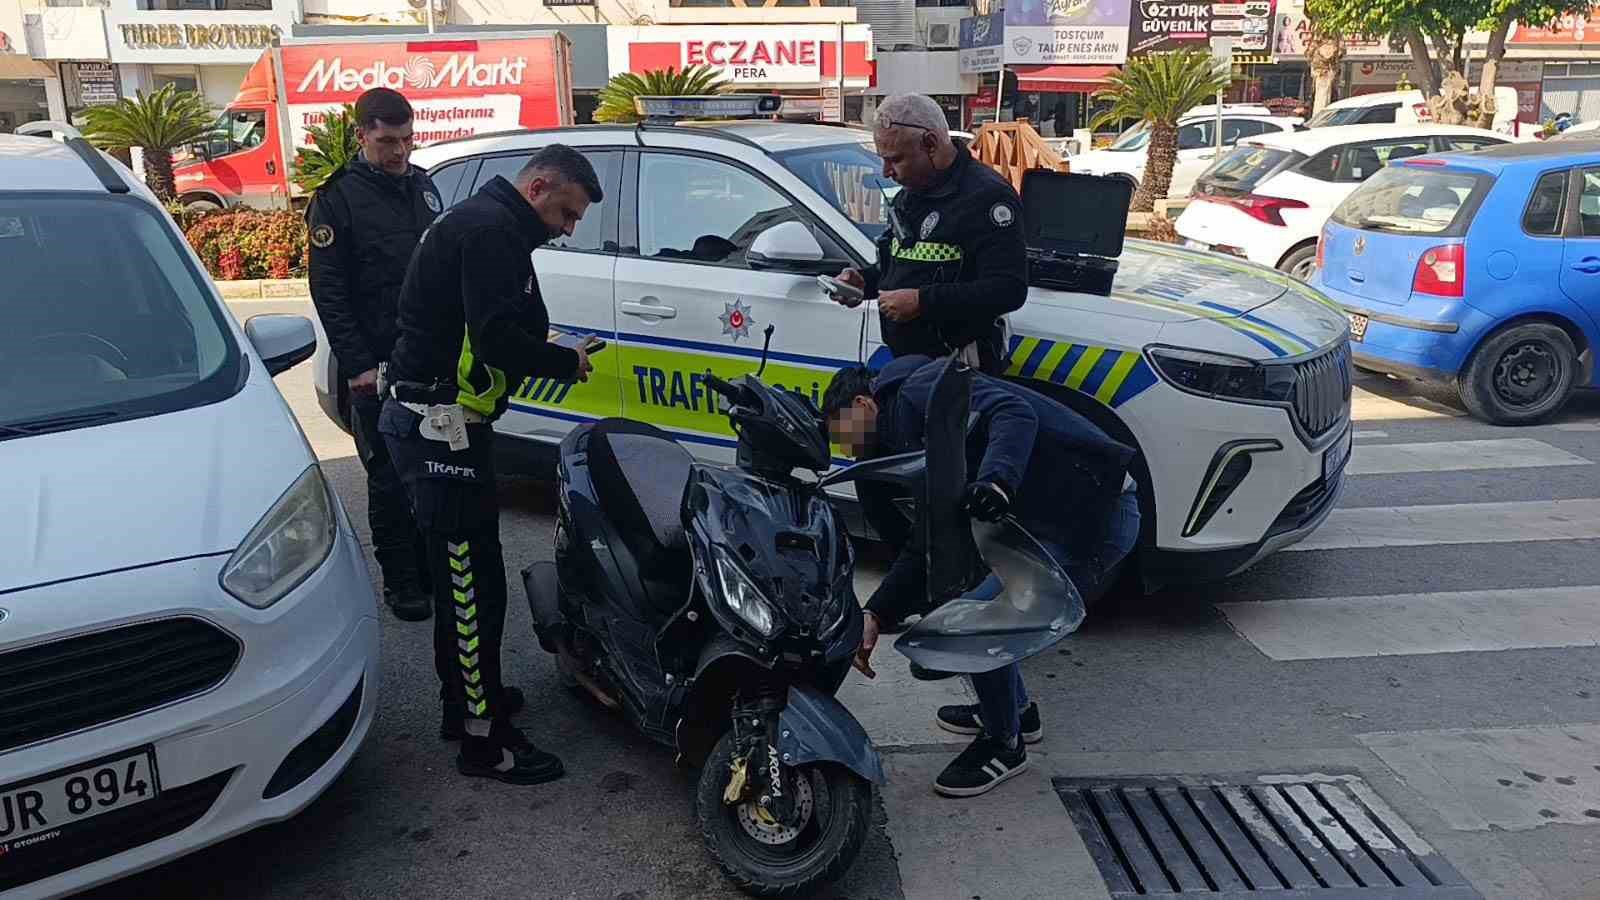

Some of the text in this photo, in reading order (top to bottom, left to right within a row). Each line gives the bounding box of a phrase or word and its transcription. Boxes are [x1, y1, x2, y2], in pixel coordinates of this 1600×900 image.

[1148, 3, 1209, 17] ÖZTÜRK
[118, 23, 184, 49] THREE
[687, 40, 816, 65] ECZANE
[1038, 41, 1119, 53] TALİP ENES AKIN
[297, 54, 527, 92] Media Markt
[735, 68, 766, 78] PERA
[410, 107, 495, 124] htiyaçlarınız
[411, 127, 474, 144] apınızda!
[768, 744, 782, 797] ARORA
[65, 760, 147, 815] 894
